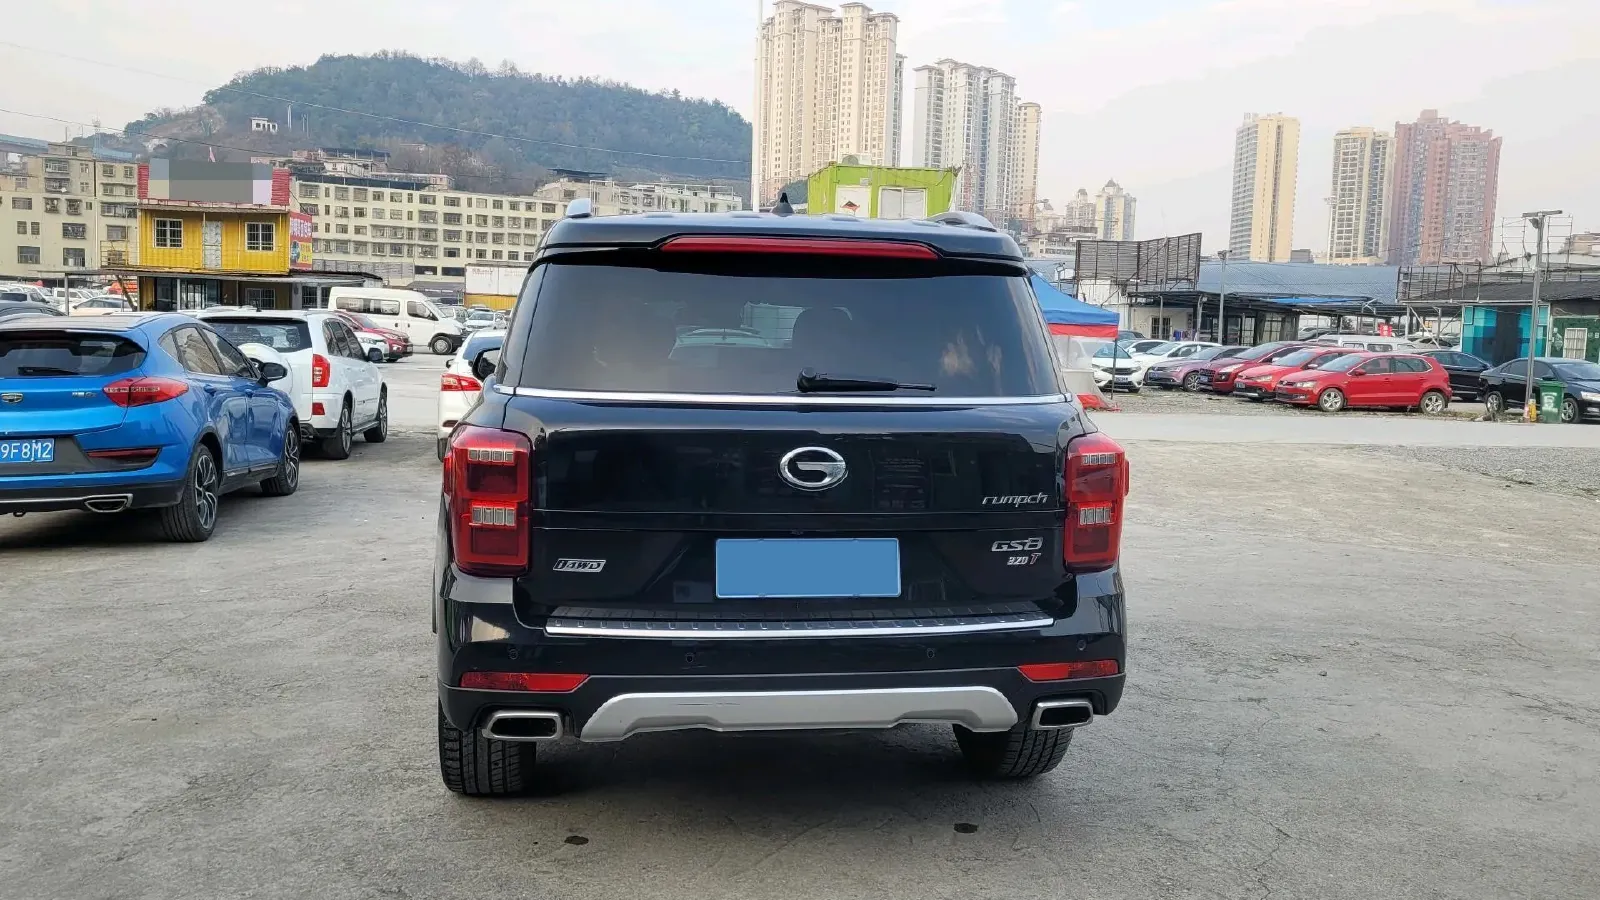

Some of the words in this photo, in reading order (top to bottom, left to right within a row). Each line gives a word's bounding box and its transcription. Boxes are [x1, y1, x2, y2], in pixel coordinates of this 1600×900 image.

[0, 442, 52, 459] 9F8M2
[982, 492, 1048, 507] rumpch
[991, 537, 1043, 552] GS8
